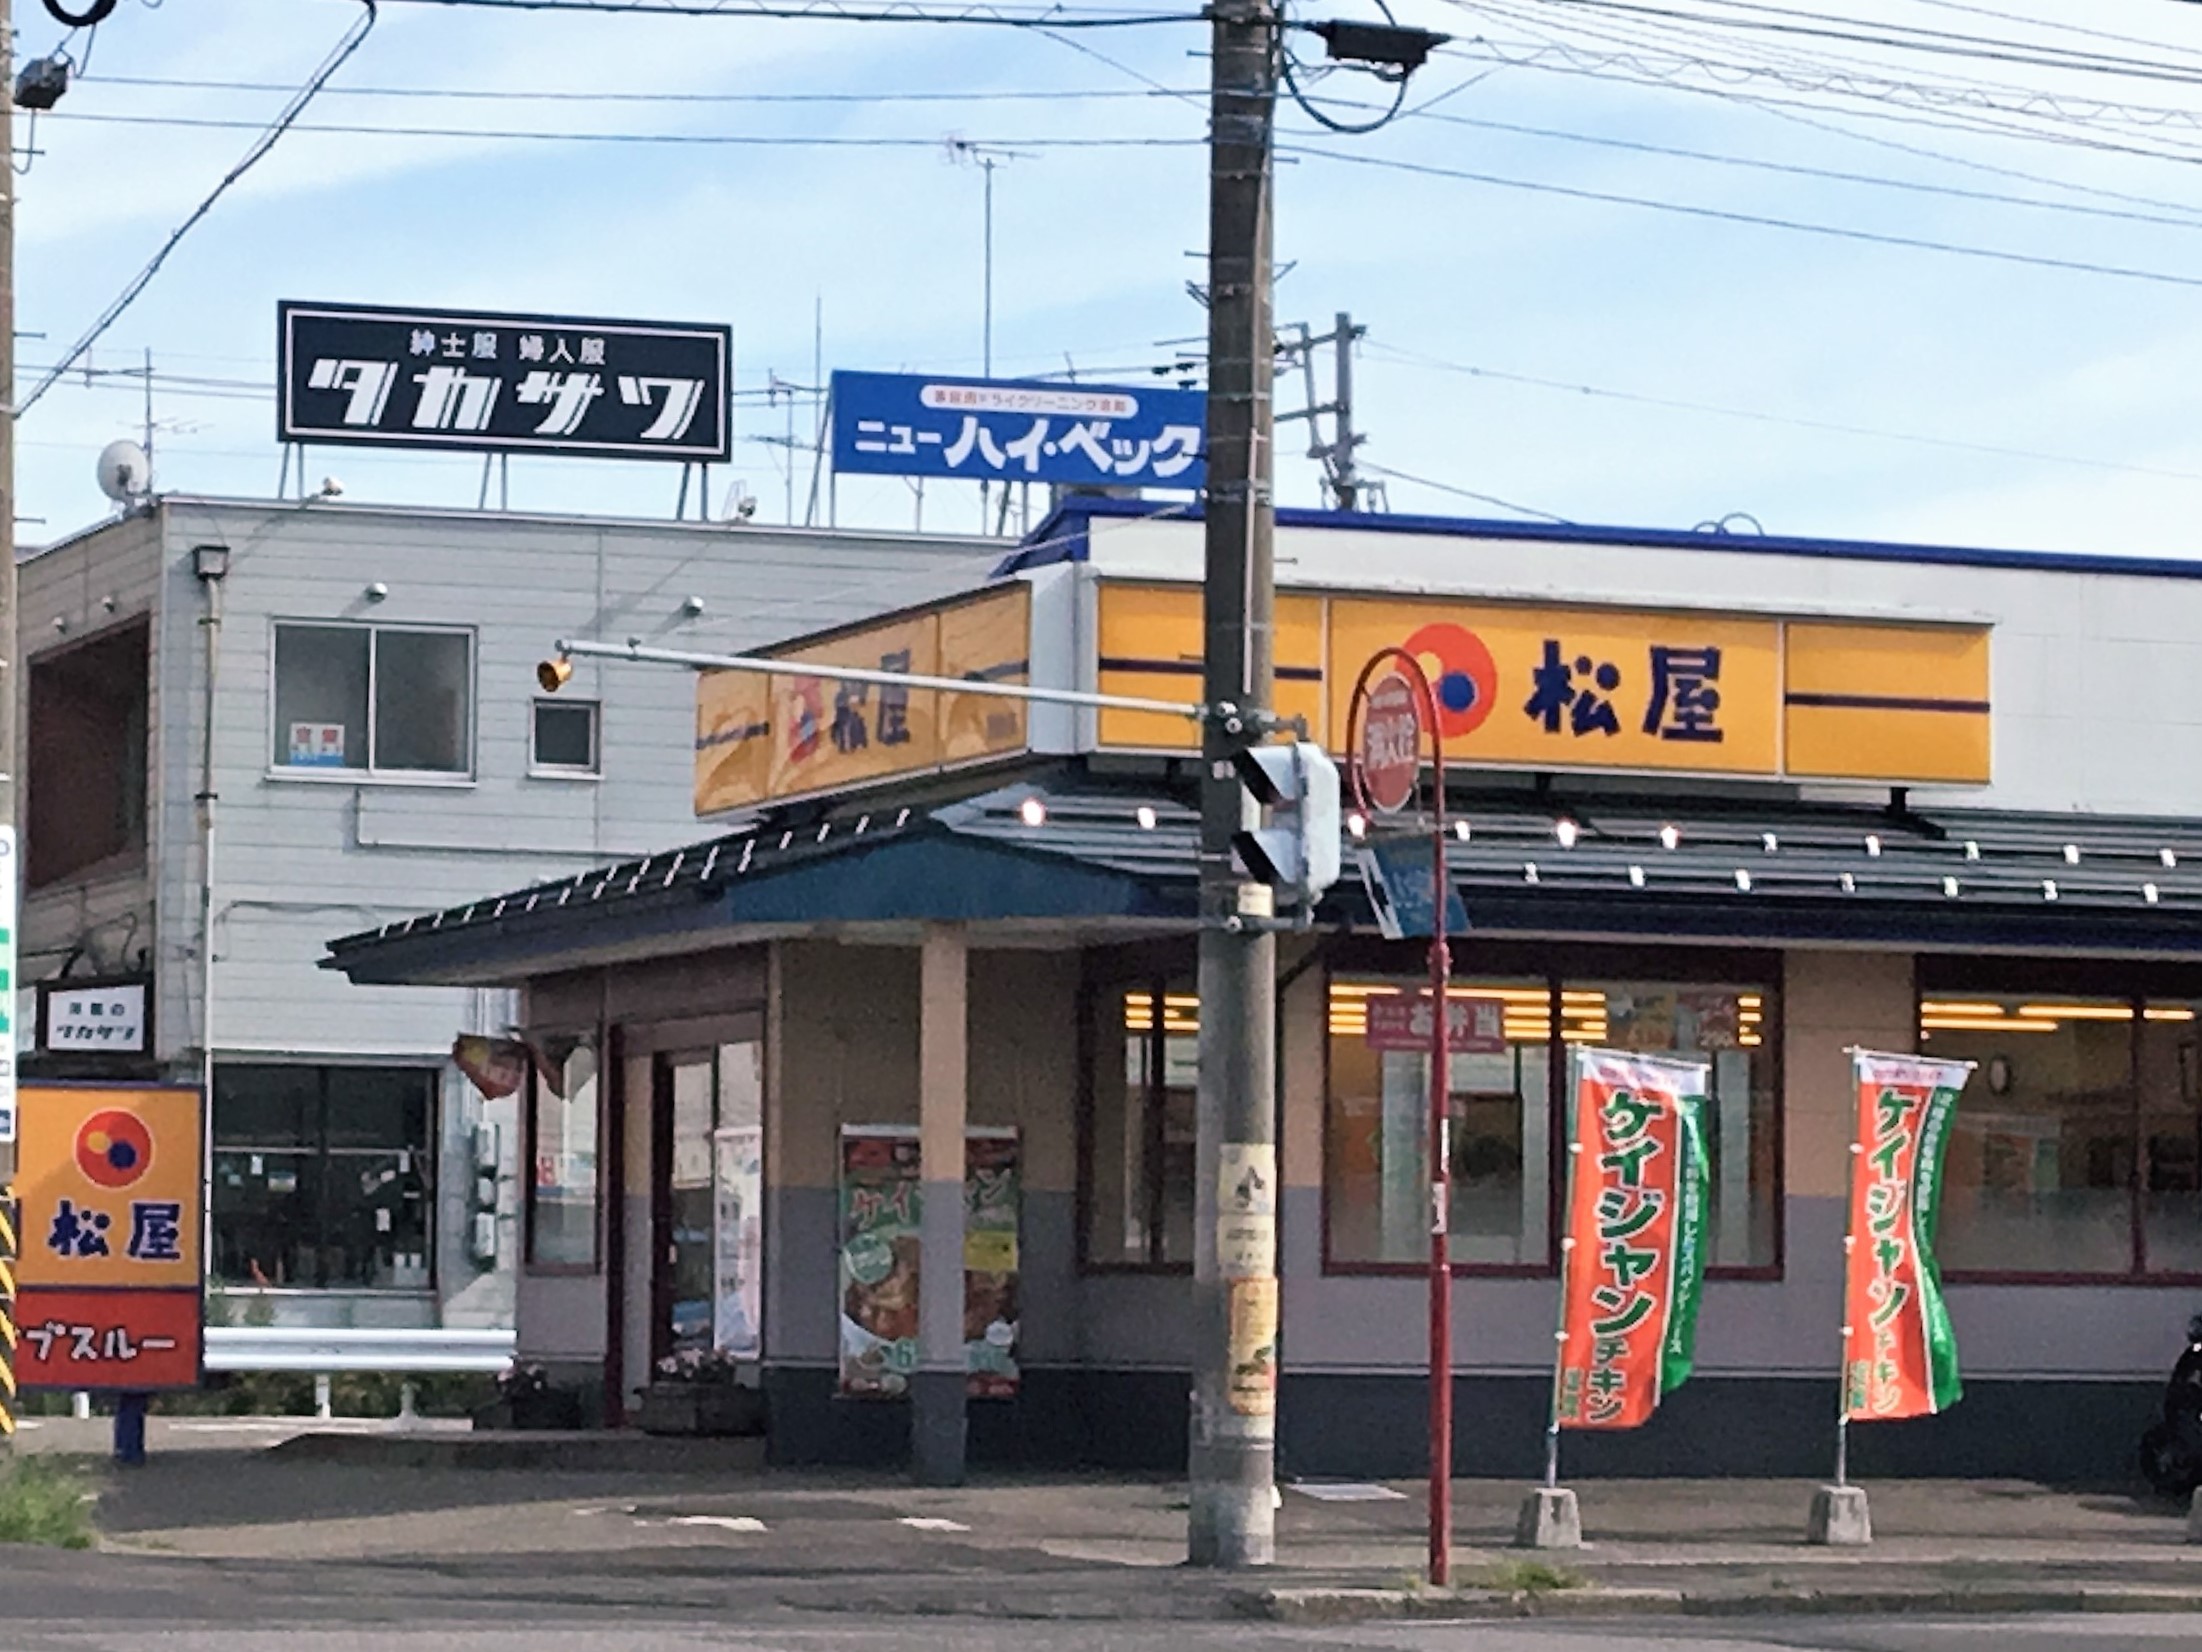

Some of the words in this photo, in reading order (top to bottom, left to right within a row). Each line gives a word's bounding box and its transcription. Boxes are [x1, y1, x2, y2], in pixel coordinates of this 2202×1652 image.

[409, 328, 498, 360] 紳士服
[518, 334, 606, 365] 婦人服
[1523, 638, 1724, 743] 松屋
[47, 1198, 183, 1262] 松屋
[17, 1321, 176, 1361] ブスルー
